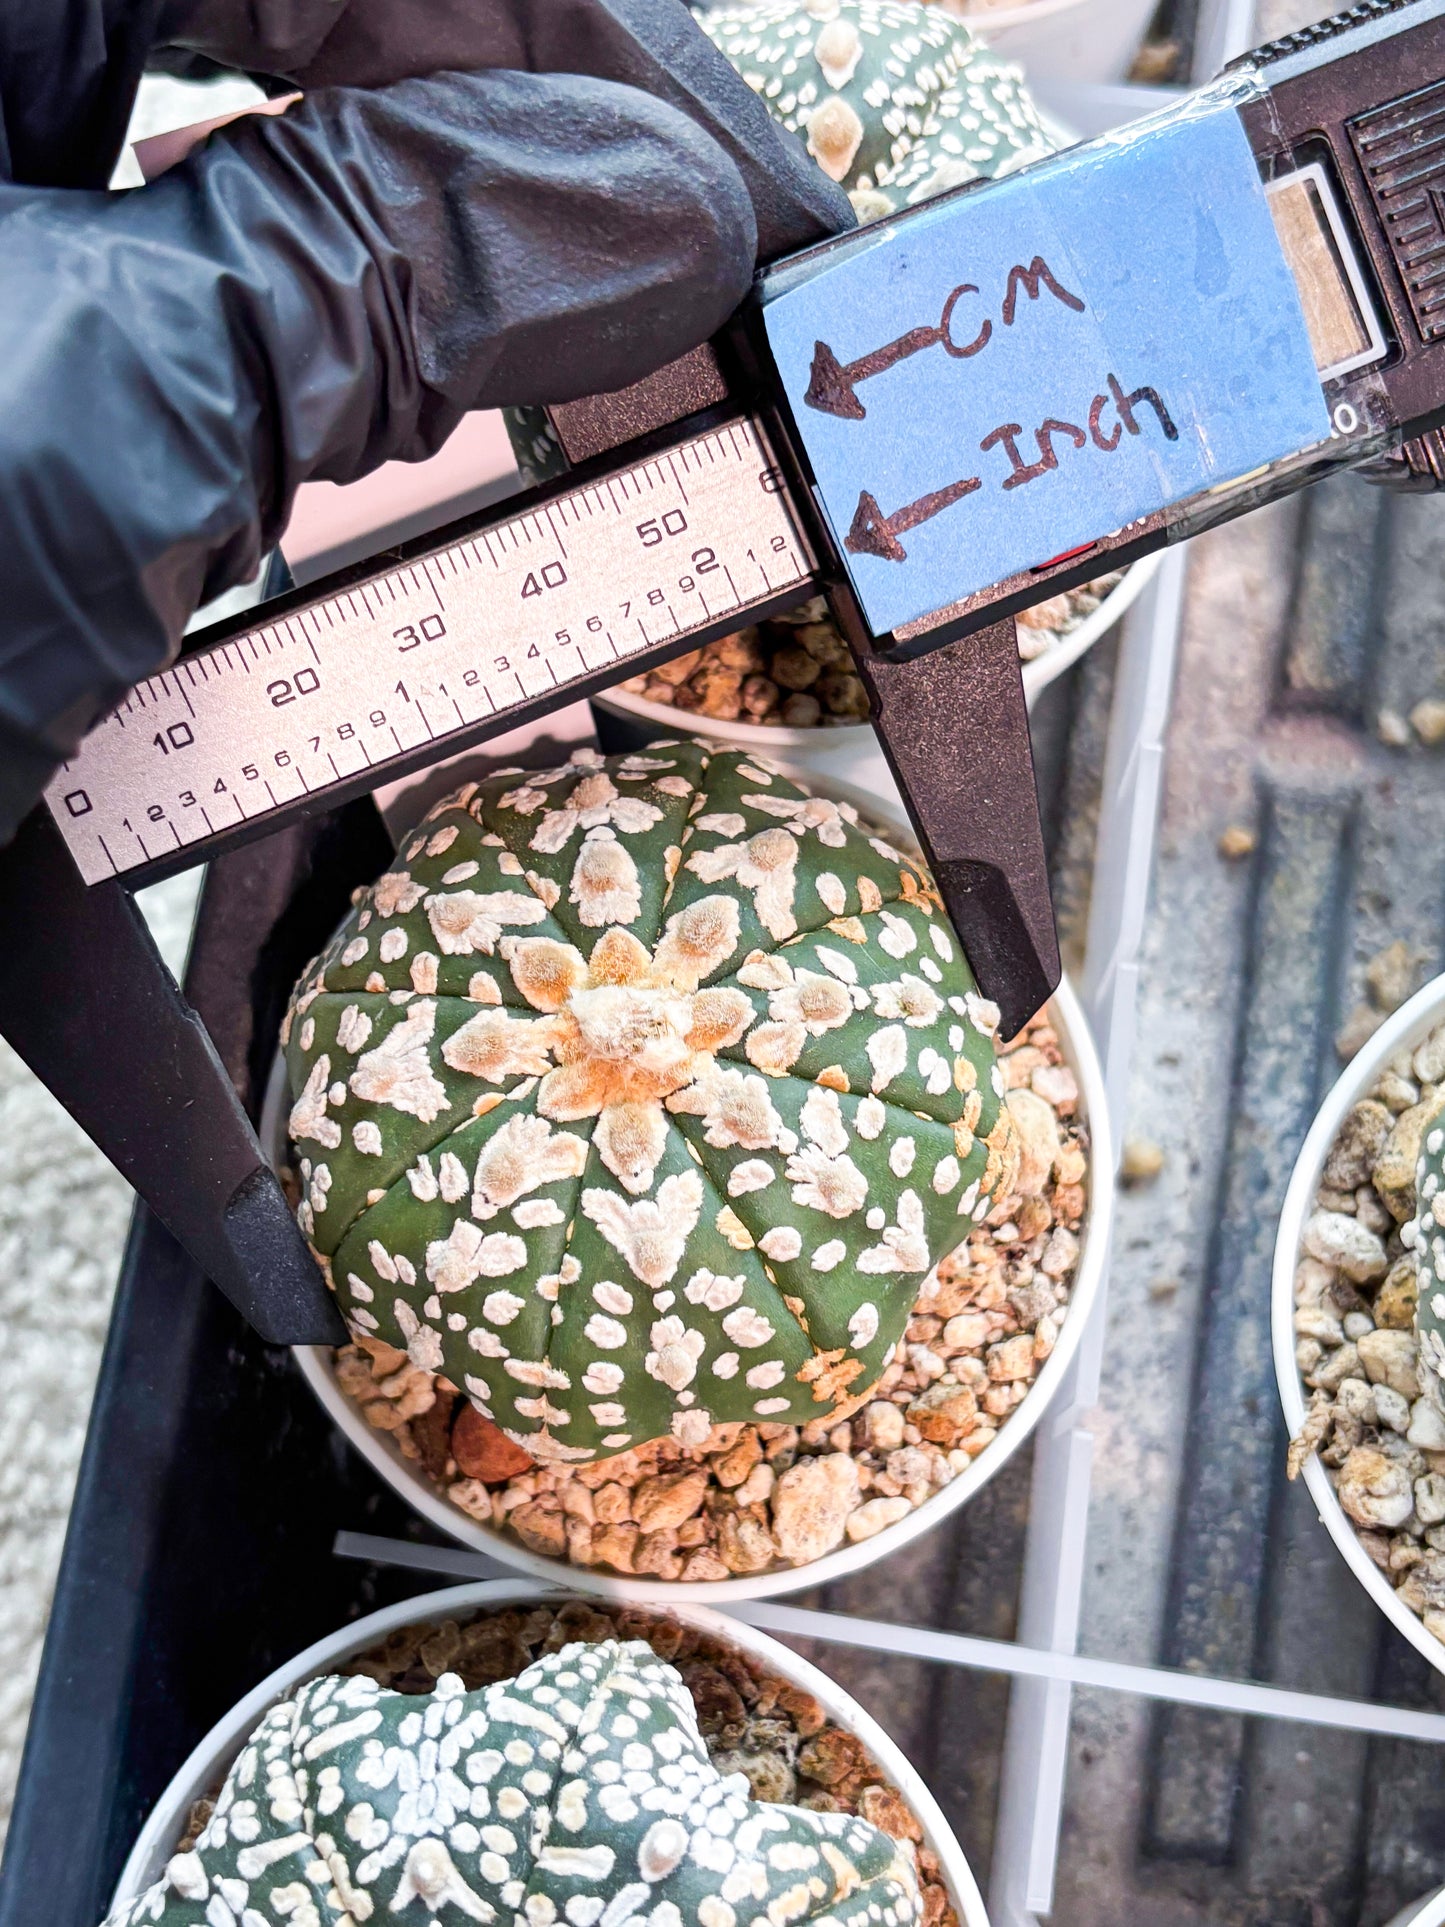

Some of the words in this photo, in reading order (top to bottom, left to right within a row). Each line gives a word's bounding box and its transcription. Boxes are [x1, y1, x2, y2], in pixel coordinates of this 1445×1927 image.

[980, 373, 1180, 490] Inch
[64, 789, 93, 817] 0
[153, 721, 195, 755] 10
[266, 667, 321, 708] 20
[393, 614, 447, 653] 30
[520, 560, 568, 600] 40
[636, 508, 689, 548] 50
[122, 818, 134, 833] 1
[146, 805, 166, 822] 2
[178, 791, 197, 808] 3
[213, 778, 229, 795] 4
[241, 763, 260, 781] 5
[274, 750, 292, 768] 6
[308, 736, 322, 753] 7
[336, 723, 356, 740] 8
[369, 710, 388, 728] 9
[394, 680, 411, 703] 1
[438, 683, 449, 697] 1
[462, 670, 481, 687] 2
[493, 656, 511, 673] 3
[526, 643, 541, 659] 4
[554, 629, 572, 646] 5
[585, 615, 603, 632] 6
[618, 601, 632, 618] 7
[646, 588, 666, 606] 8
[678, 575, 696, 594] 9
[691, 547, 720, 575] 2
[746, 549, 757, 563] 1
[769, 535, 788, 553] 2
